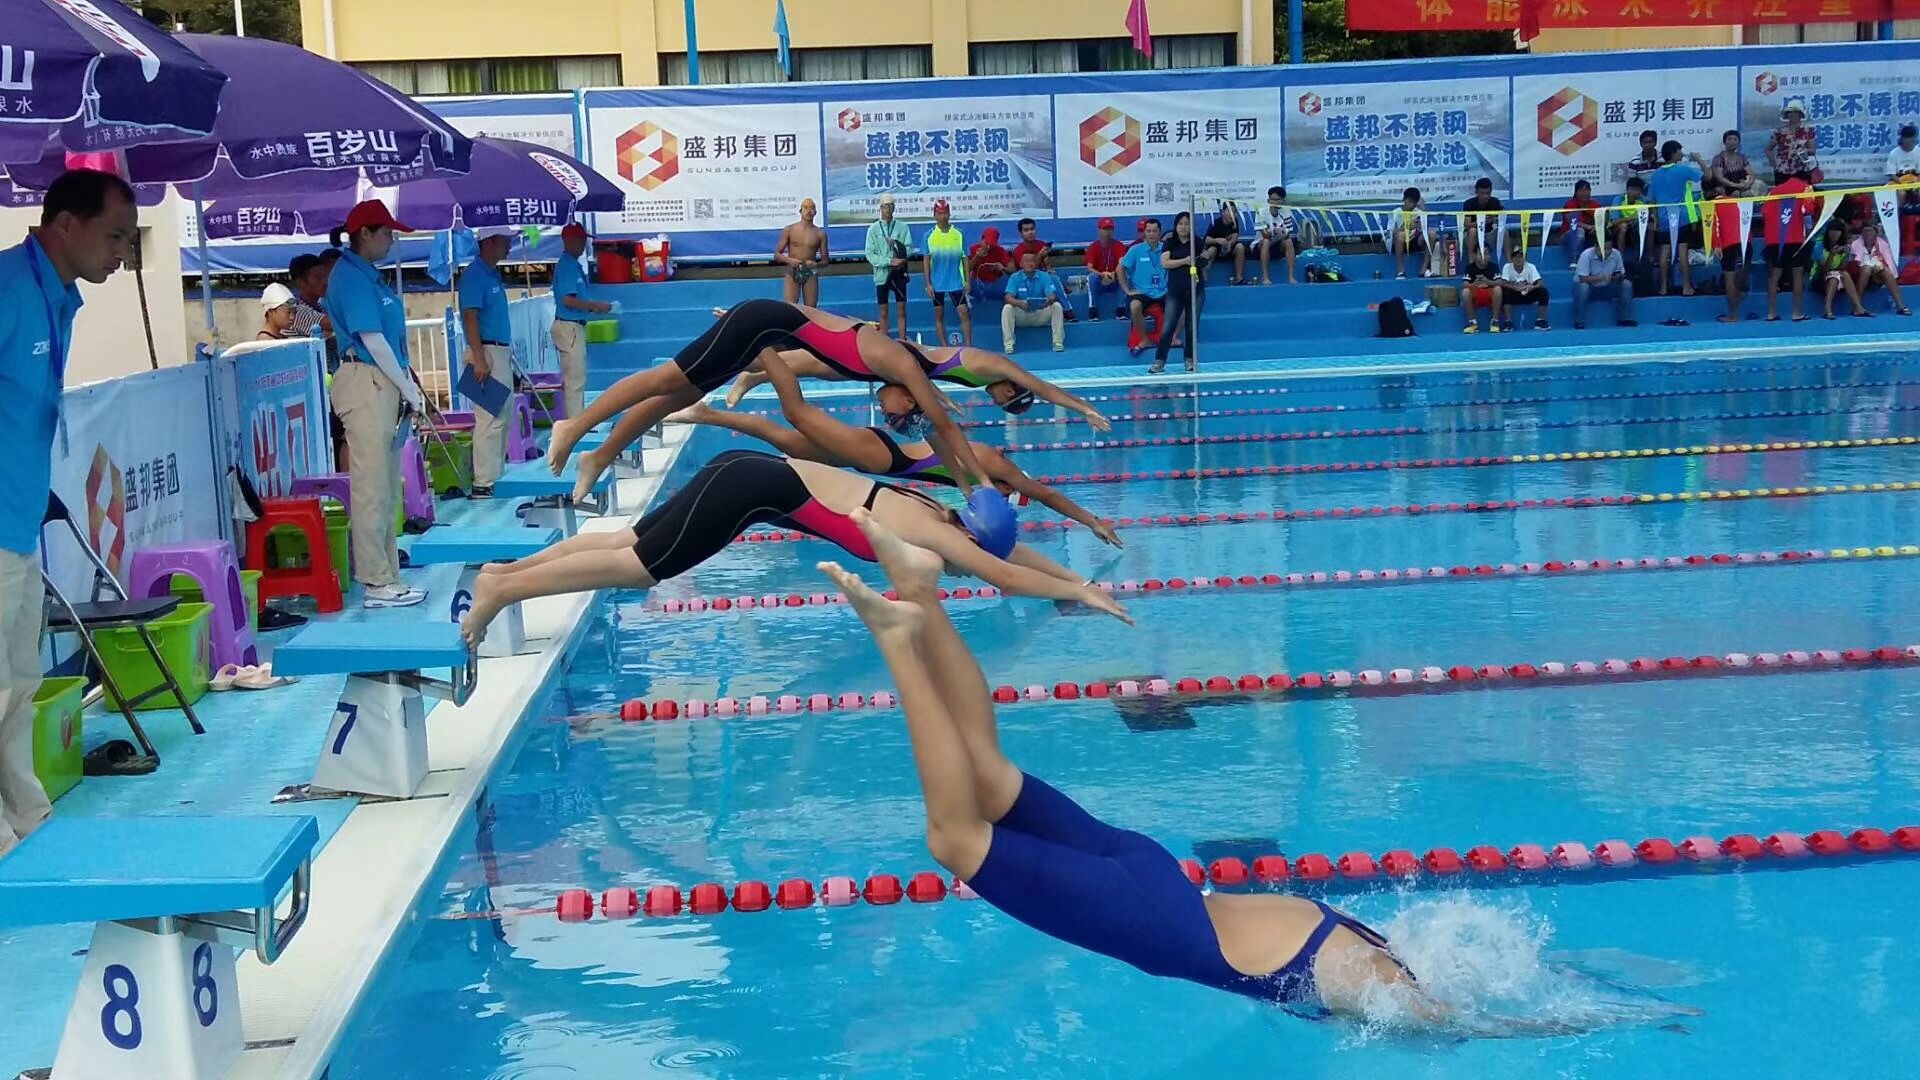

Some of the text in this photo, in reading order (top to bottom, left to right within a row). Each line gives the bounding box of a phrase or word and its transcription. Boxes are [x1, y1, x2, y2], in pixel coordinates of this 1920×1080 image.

[1323, 96, 1366, 107] 盛邦集团
[1603, 97, 1714, 124] 盛邦集团
[1784, 90, 1920, 119] 邦不锈钢
[862, 112, 906, 123] 盛邦集团
[1146, 117, 1258, 144] 盛邦集团
[1325, 109, 1468, 142] 盛邦不锈钢
[304, 129, 399, 158] 百岁山
[683, 133, 797, 160] 盛邦集团
[866, 127, 1009, 158] 盛邦不锈钢
[1606, 128, 1714, 139] SUNBEGROUP
[250, 143, 298, 160] 水中贵族
[1148, 149, 1257, 159] SUNBASEGROUP
[1325, 140, 1468, 172] 拼装游泳池
[687, 165, 797, 174] SUNBASEGROUP
[866, 158, 1011, 189] 拼装游泳池
[237, 207, 281, 225] 百岁山
[505, 198, 558, 217] 百岁山
[125, 452, 181, 513] 盛邦集团
[332, 701, 358, 755] 7
[193, 942, 218, 1027] 8
[101, 964, 142, 1050] 8
